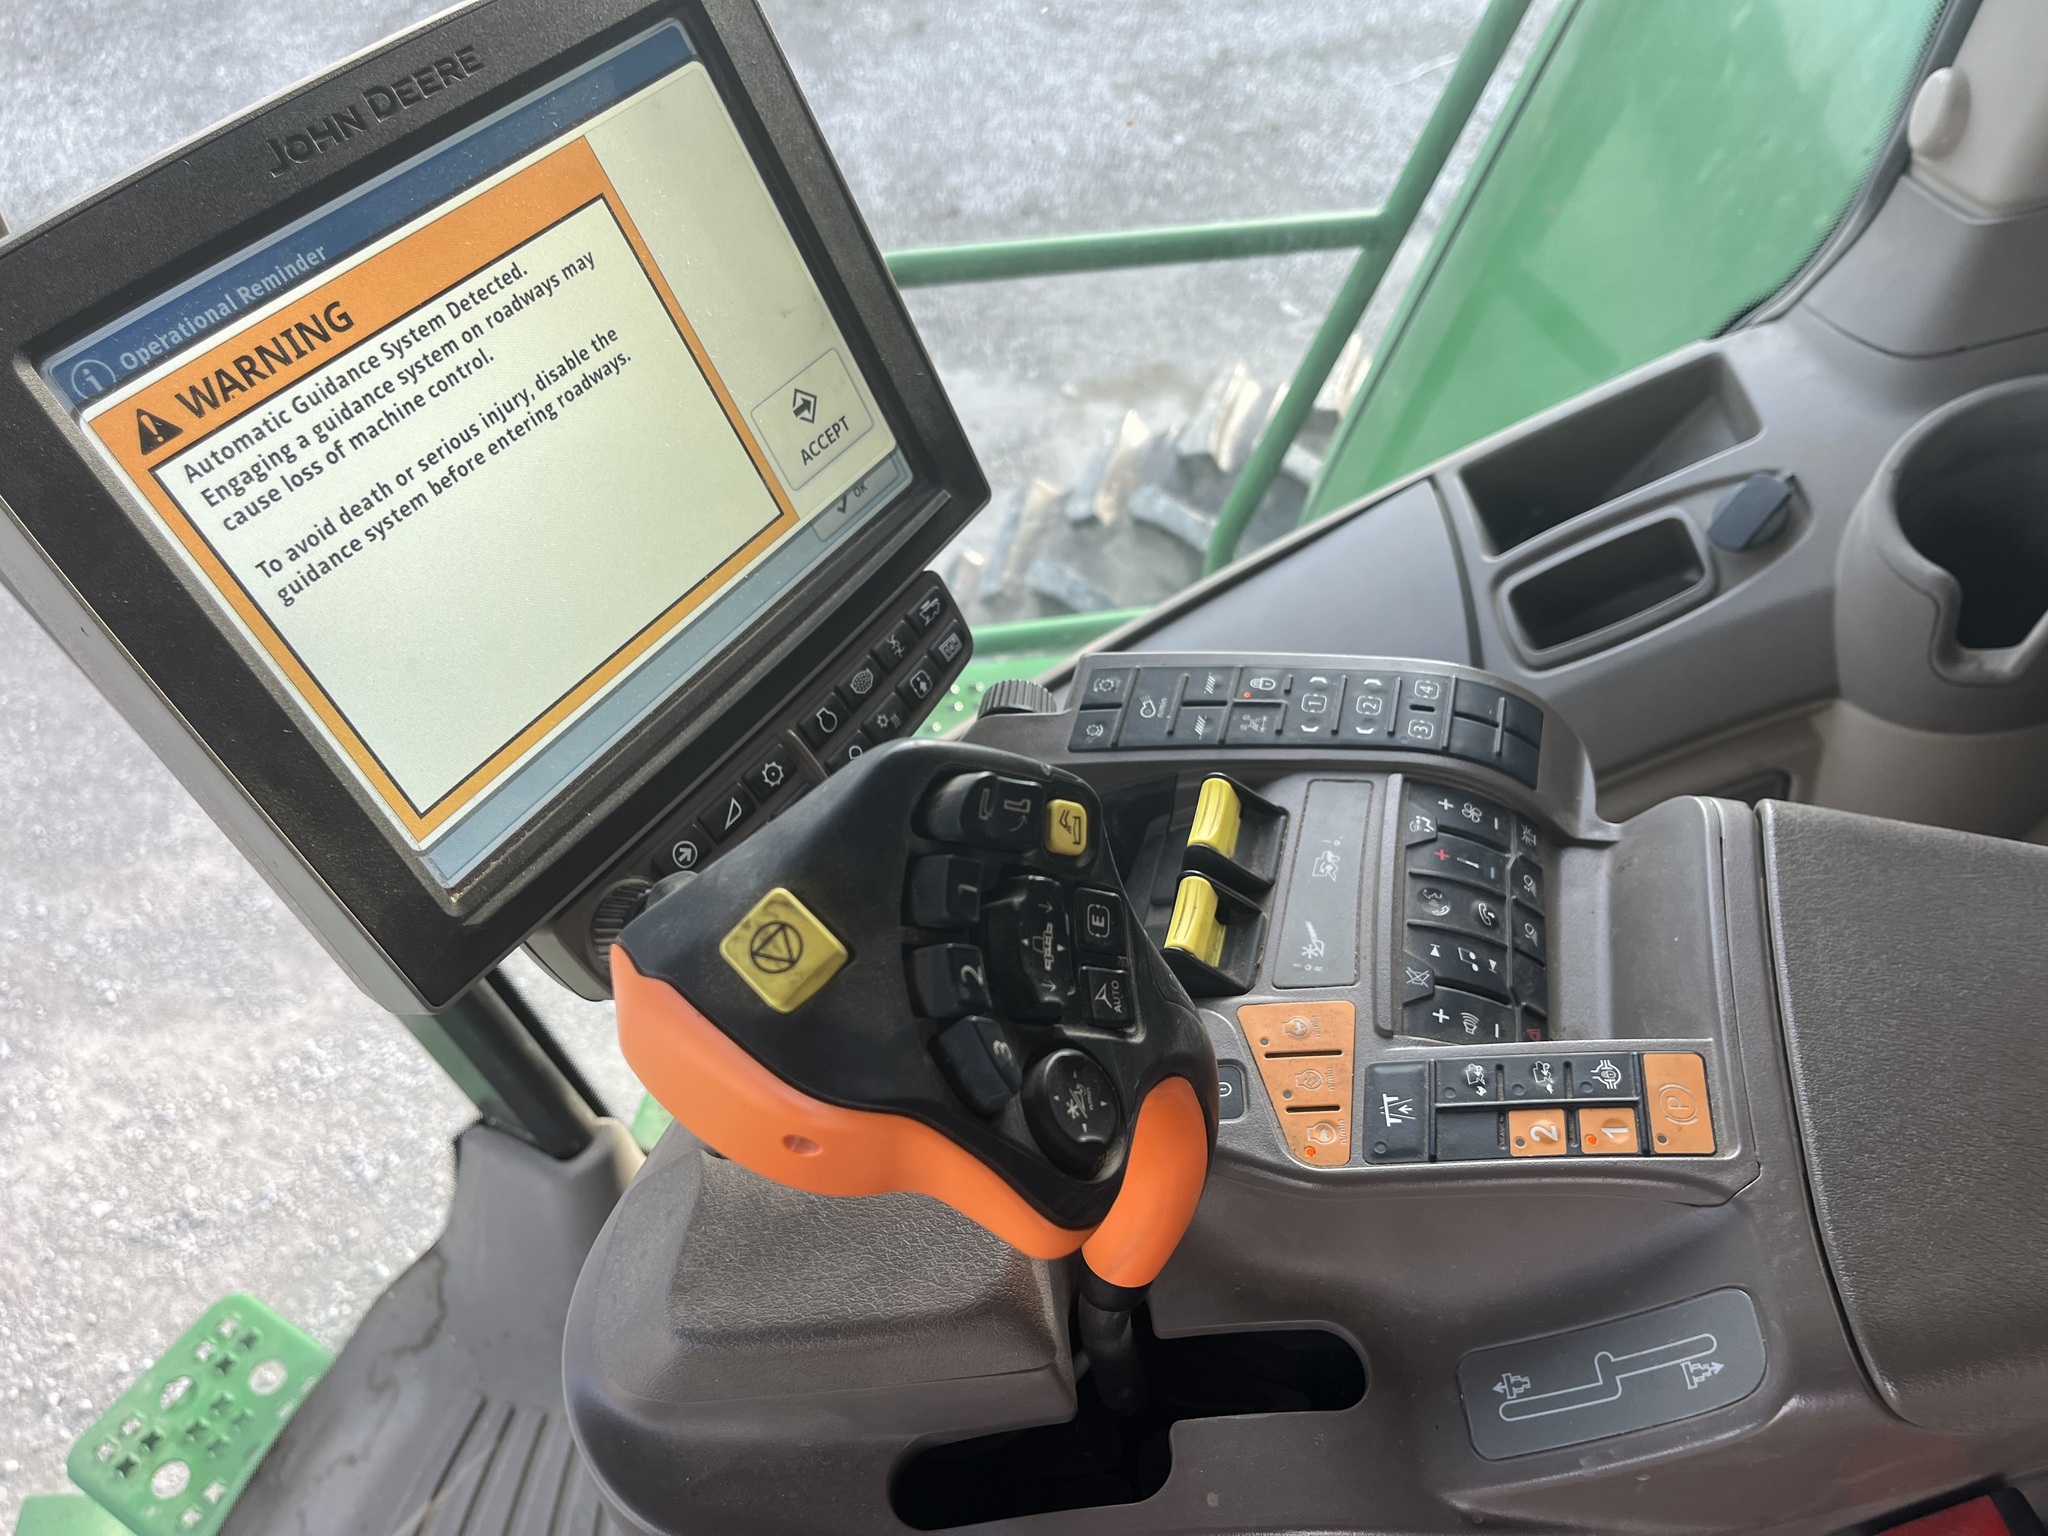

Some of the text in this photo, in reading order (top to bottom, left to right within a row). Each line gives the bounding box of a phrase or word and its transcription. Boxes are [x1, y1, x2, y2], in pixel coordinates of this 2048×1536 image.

[266, 45, 485, 178] JOHN DEERE
[119, 246, 328, 371] Operational Reminder
[175, 300, 355, 419] WARNING
[184, 262, 528, 484] Automatic Guidance System Detected.
[200, 252, 595, 508] Engaging a guidance system on roadways may
[223, 348, 494, 531] cause loss of machine control.
[255, 329, 618, 579] To avoid death or serious injury, disable the
[800, 416, 850, 466] ACCEPT
[277, 353, 631, 607] guidance system before entering roadways.
[853, 482, 868, 498] OK
[957, 883, 978, 894] 1
[960, 964, 984, 987] 2
[1111, 980, 1122, 1013] AUTO
[993, 1039, 1013, 1061] 3
[1666, 1095, 1690, 1110] P
[1530, 1125, 1559, 1142] 2
[1601, 1126, 1629, 1139] 1
